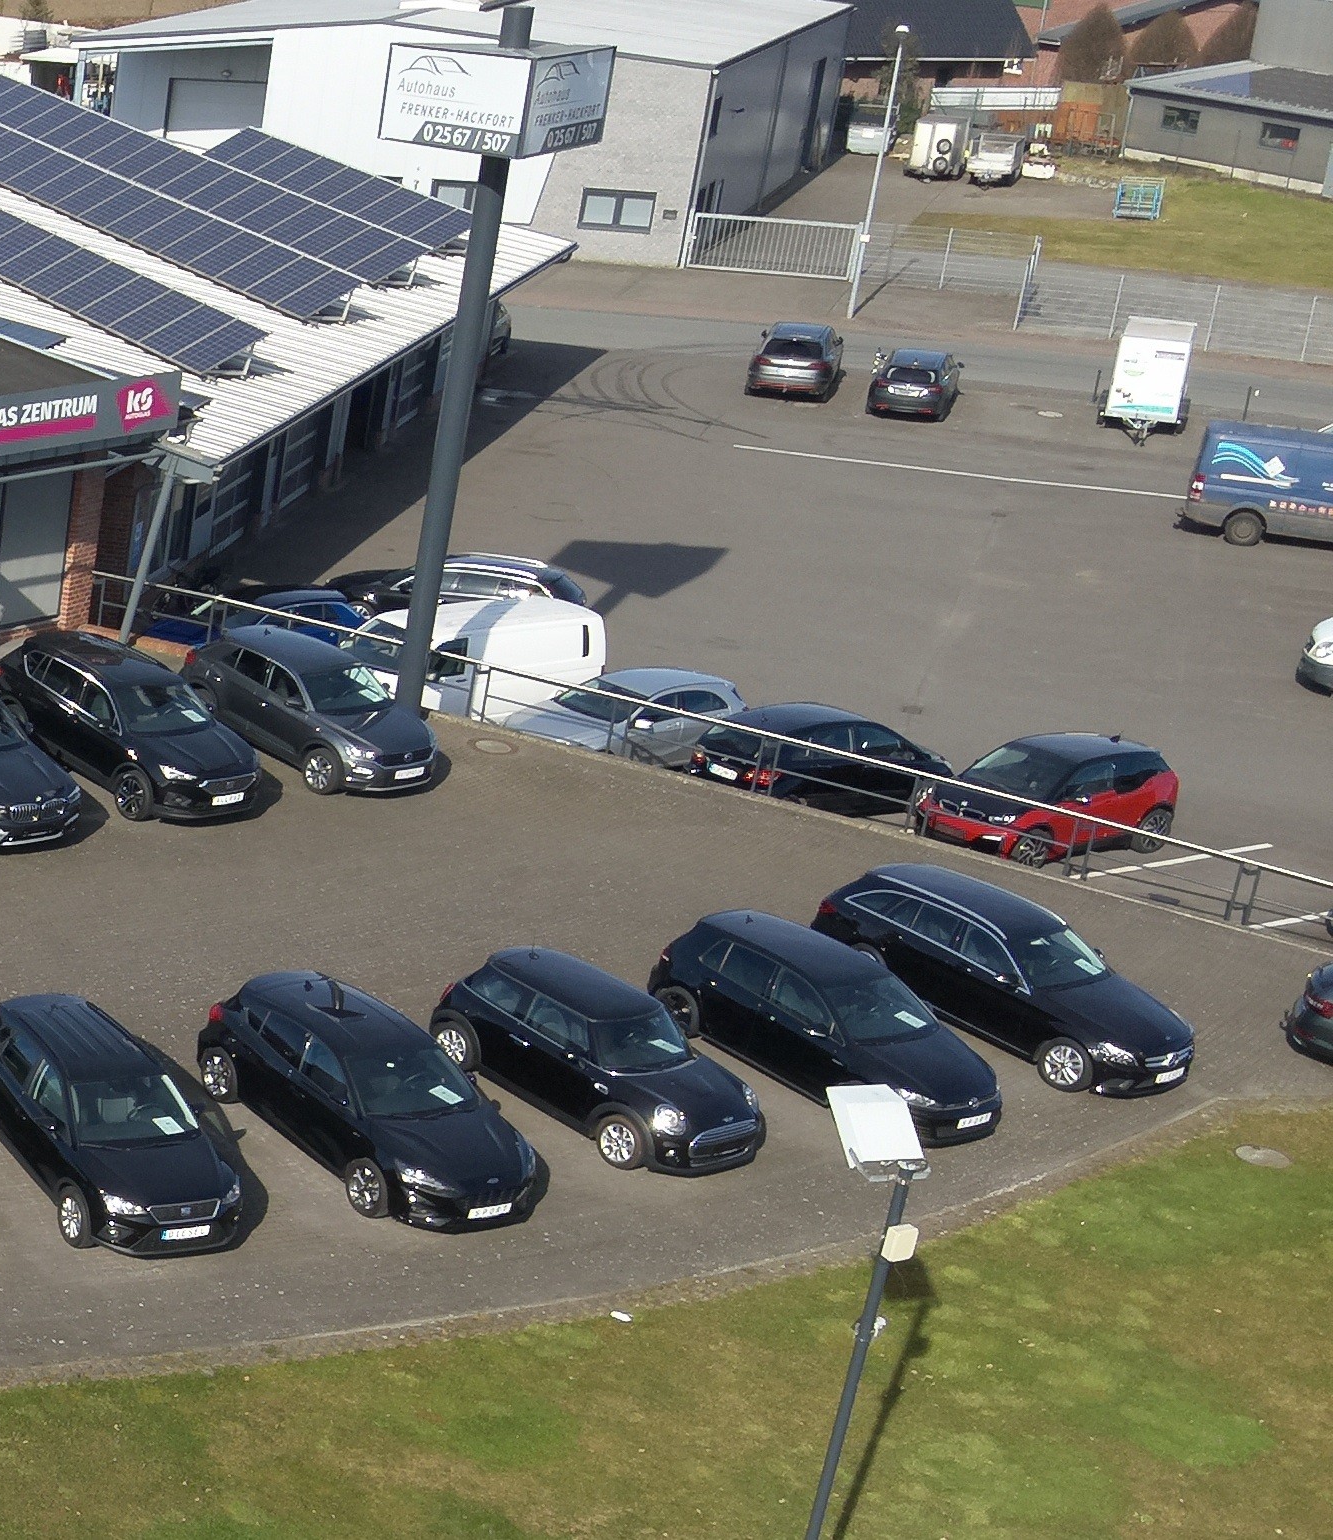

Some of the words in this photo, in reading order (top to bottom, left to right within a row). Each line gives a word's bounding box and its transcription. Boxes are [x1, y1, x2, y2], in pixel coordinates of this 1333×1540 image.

[397, 77, 456, 99] Autohaus
[400, 101, 515, 129] FRENKER-HACKFORT
[19, 394, 98, 424] ZENTRUM
